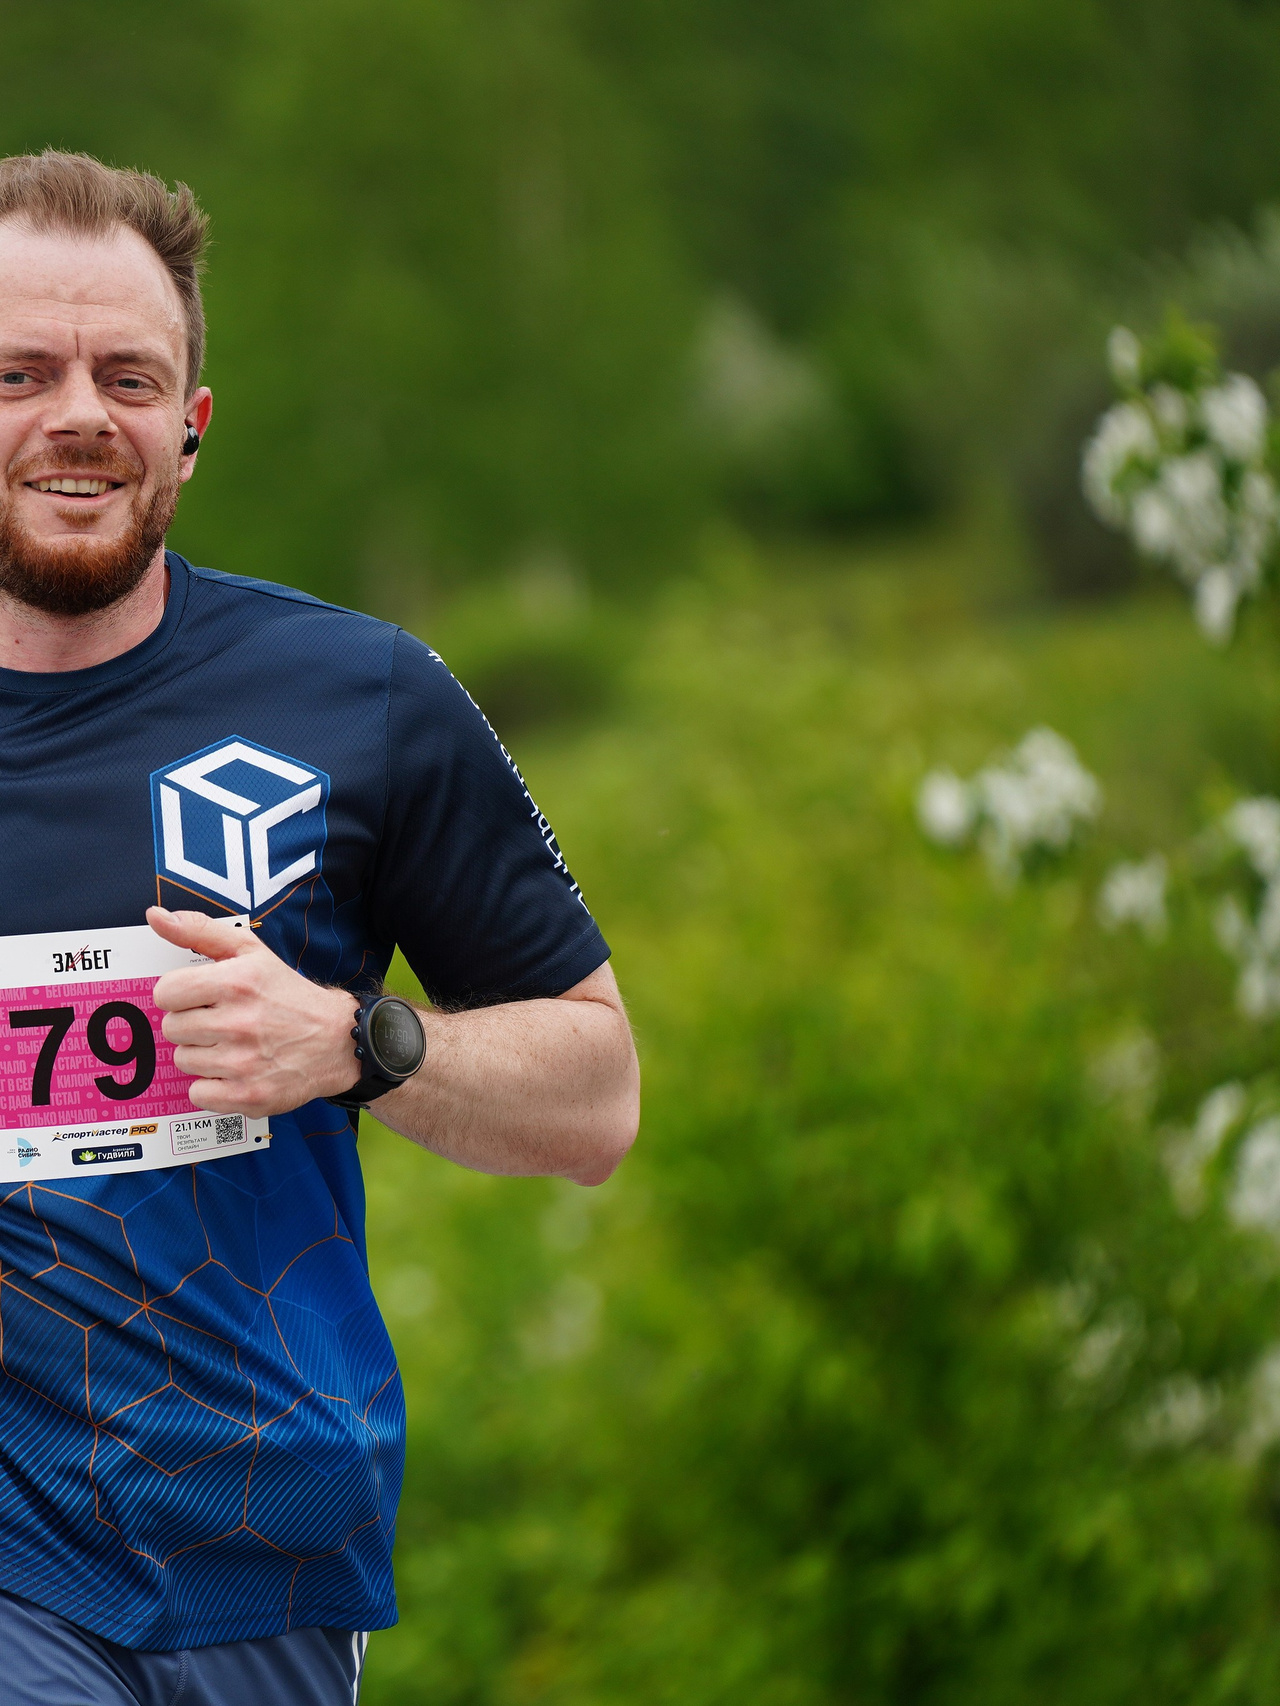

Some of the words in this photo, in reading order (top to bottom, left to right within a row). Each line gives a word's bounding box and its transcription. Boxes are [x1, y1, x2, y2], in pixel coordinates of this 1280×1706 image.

[45, 983, 90, 999] БЕГОВАЯ
[67, 1036, 81, 1051] ЗА
[9, 1001, 156, 1107] 79
[57, 1055, 94, 1071] СТАРТЕ
[7, 1078, 15, 1092] В
[49, 1090, 81, 1106] ТСТАЛ
[150, 1083, 164, 1097] ЗА
[17, 1111, 58, 1127] ТОЛЬКО
[58, 1108, 98, 1124] НАЧАЛО
[113, 1105, 128, 1120] НА
[129, 1101, 166, 1118] СТАРТЕ
[130, 1124, 157, 1135] PRO
[175, 1122, 192, 1133] 21.1
[194, 1119, 212, 1130] КМ
